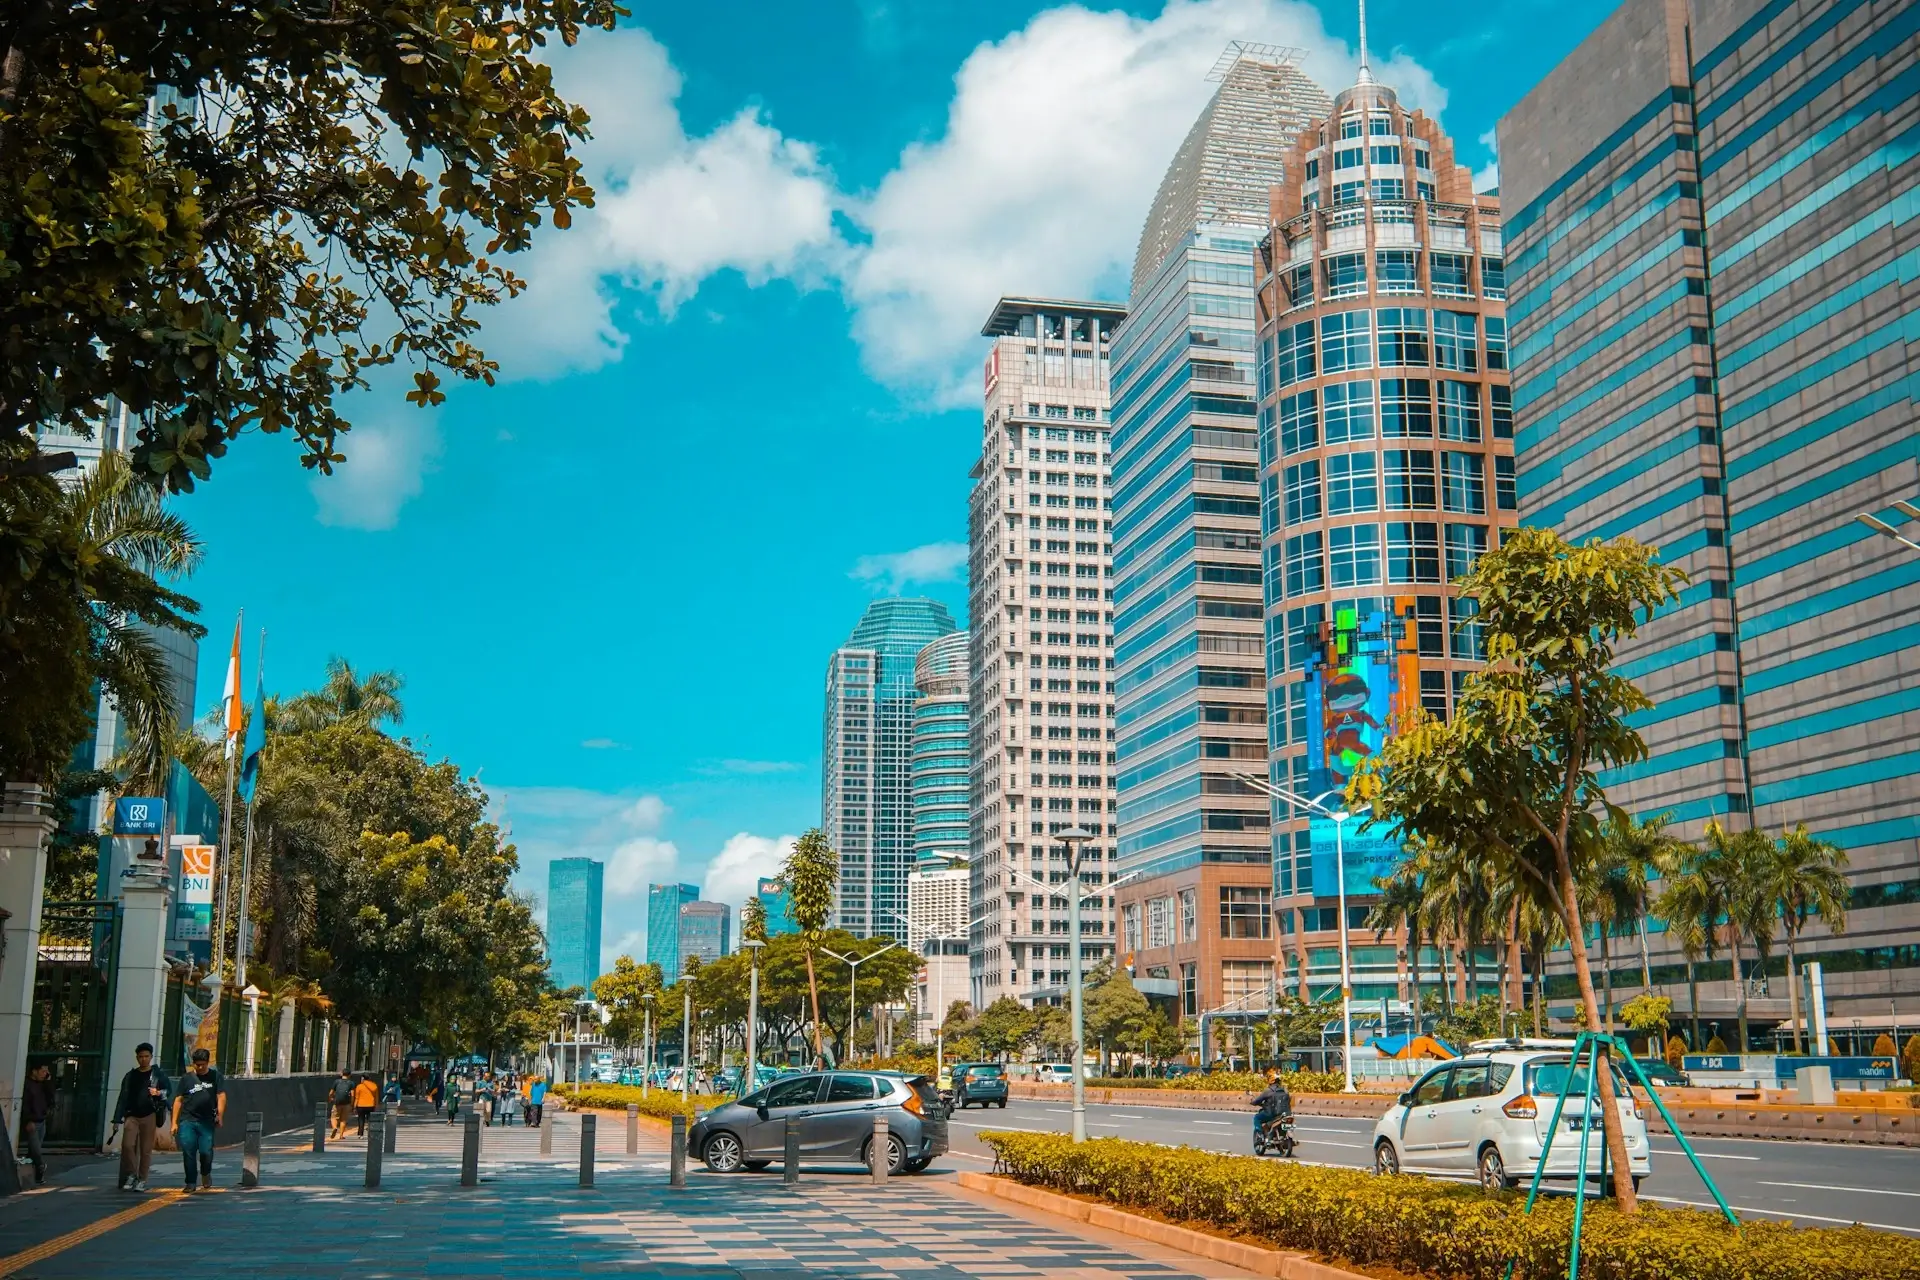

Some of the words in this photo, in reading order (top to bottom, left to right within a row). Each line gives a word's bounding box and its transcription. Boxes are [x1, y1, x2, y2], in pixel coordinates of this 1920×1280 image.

[182, 878, 209, 890] BNI
[762, 884, 780, 892] AIA
[1709, 1057, 1723, 1068] BCA
